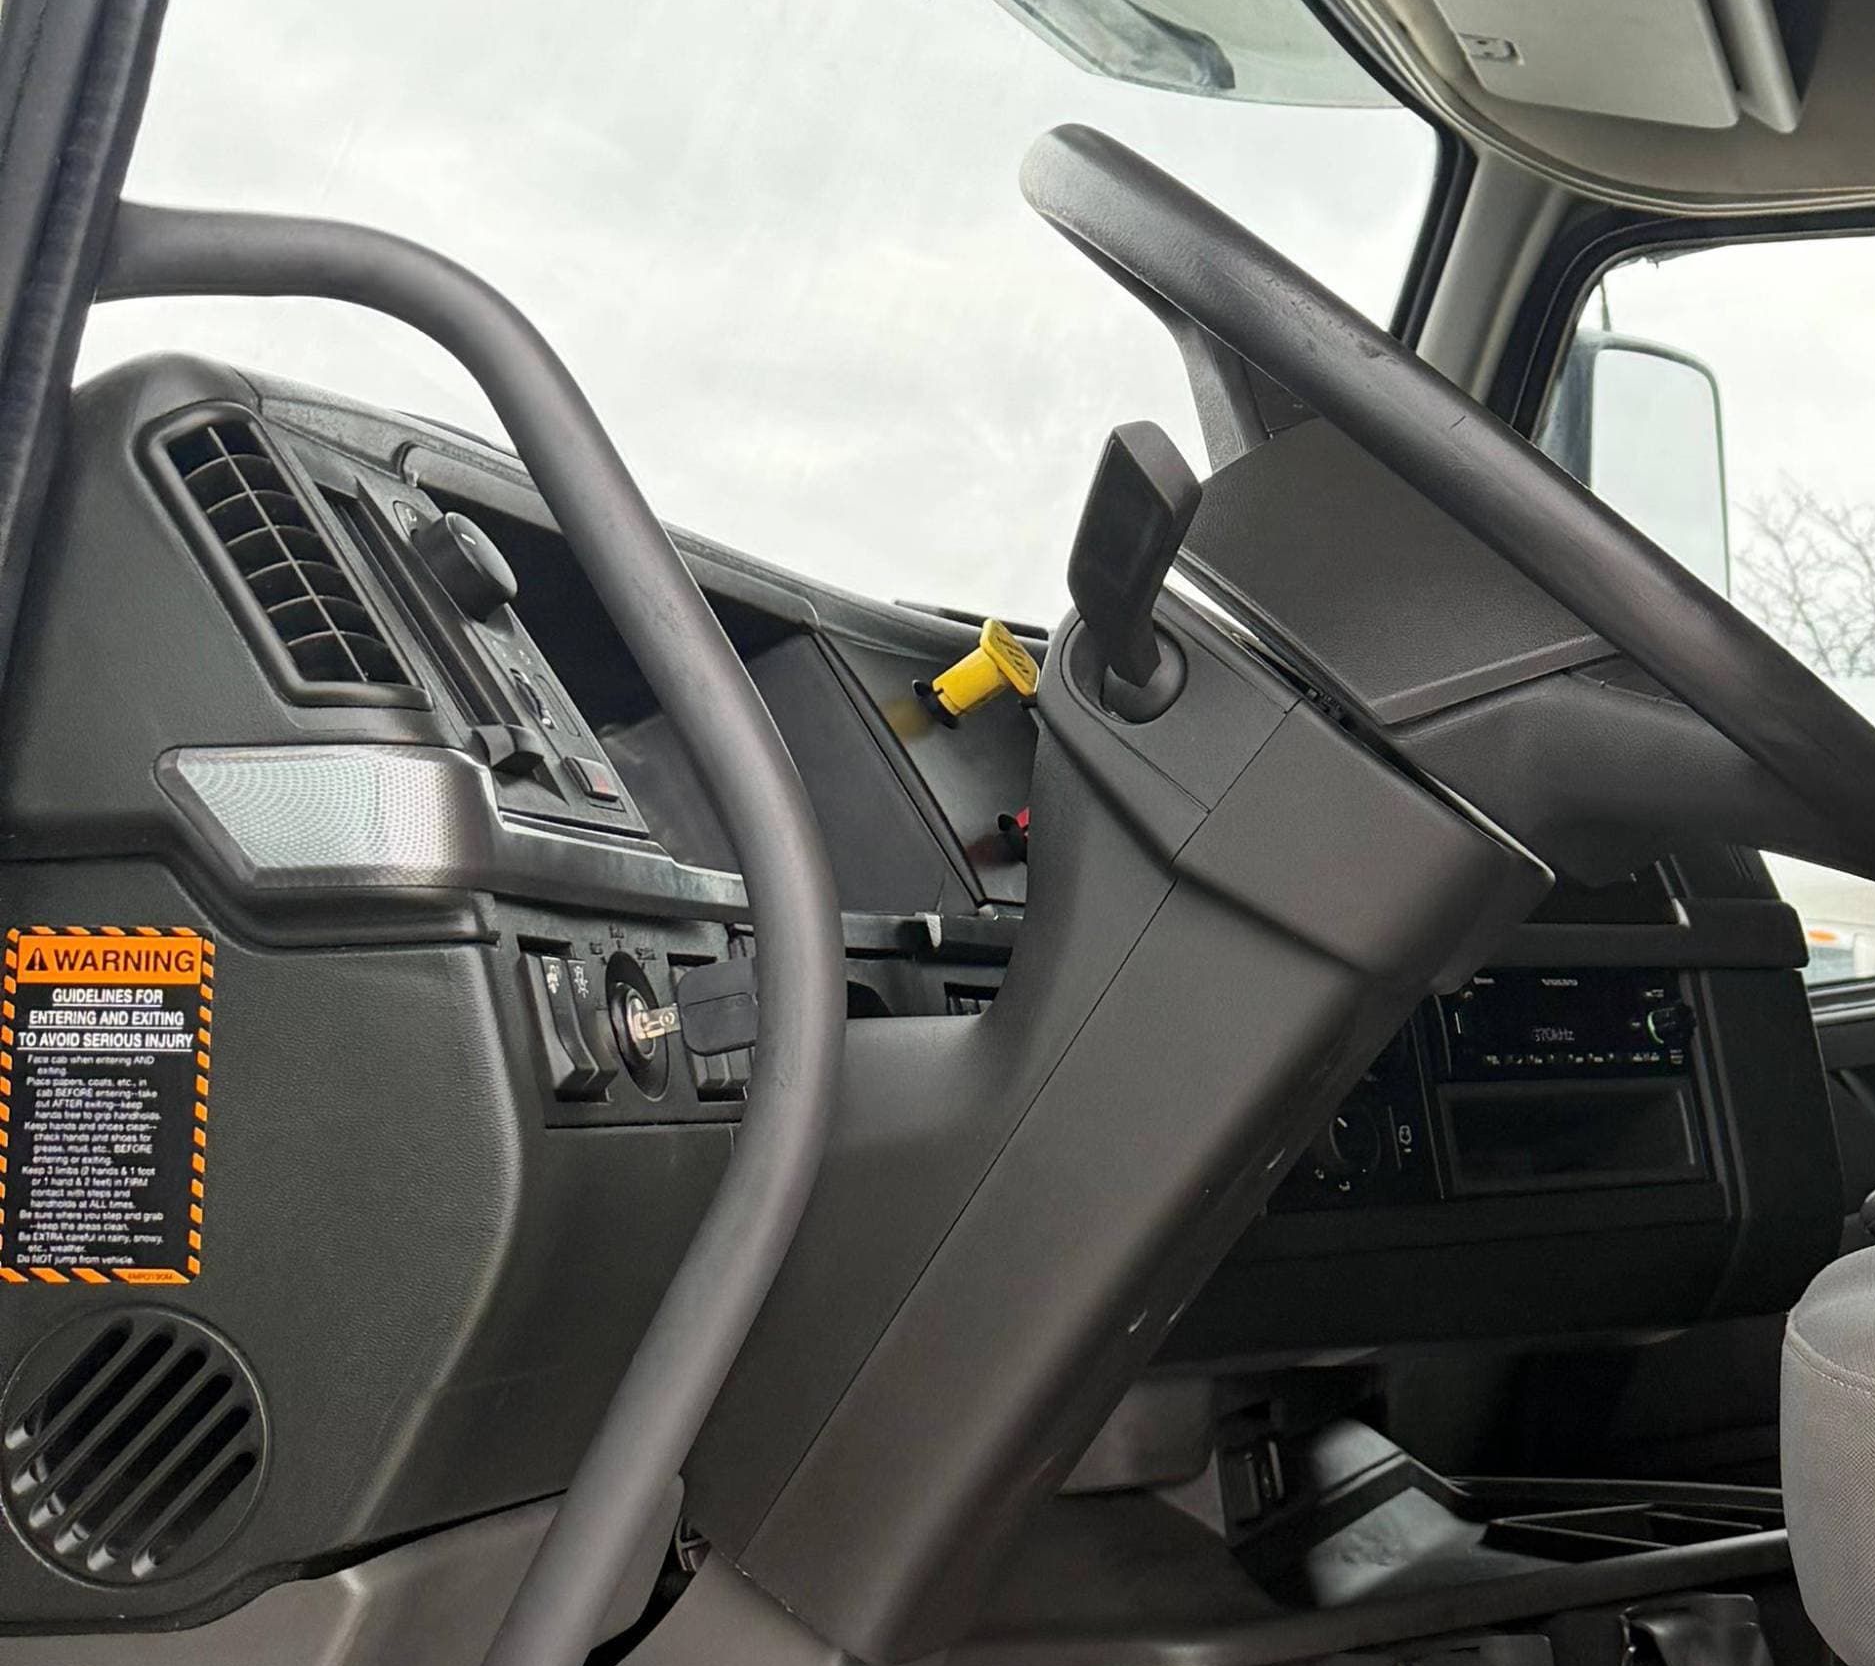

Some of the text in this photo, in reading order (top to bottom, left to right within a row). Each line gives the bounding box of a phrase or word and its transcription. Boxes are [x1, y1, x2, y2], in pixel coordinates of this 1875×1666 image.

[53, 950, 195, 973] WARNING
[52, 989, 163, 1004] GUIDELINES FOR
[29, 1010, 184, 1026] ENTERING AND EXITING
[18, 1033, 193, 1048] TO AVOID SERIOUS INJURY
[28, 1055, 155, 1066] Face cab when entering AND
[26, 1077, 50, 1086] Place
[55, 1088, 93, 1097] BEFORE
[24, 1122, 47, 1131] Keep
[50, 1122, 76, 1130] hands
[78, 1123, 95, 1131] and
[124, 1212, 141, 1220] and
